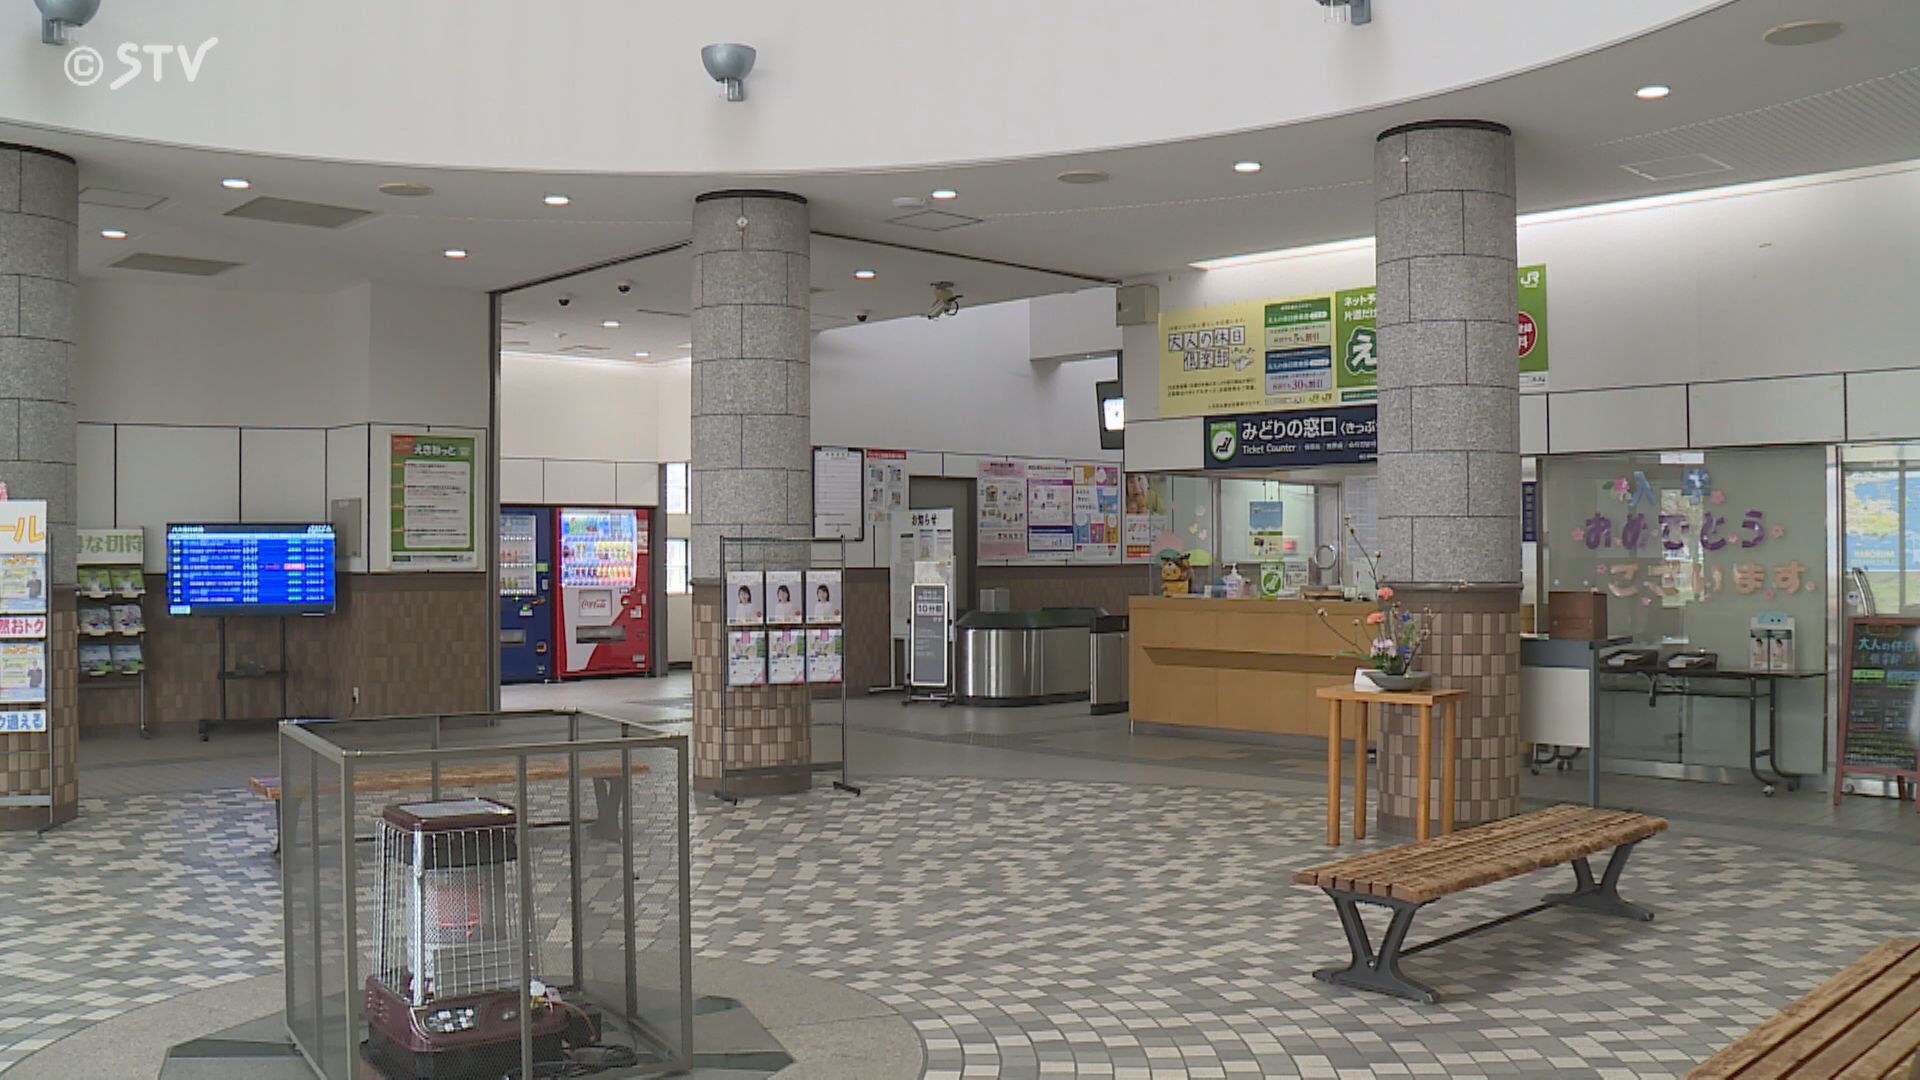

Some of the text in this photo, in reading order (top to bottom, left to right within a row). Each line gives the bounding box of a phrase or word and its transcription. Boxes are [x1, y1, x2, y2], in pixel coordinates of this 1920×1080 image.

[1520, 270, 1540, 285] JR
[1168, 327, 1245, 350] 大人の休日
[1242, 445, 1265, 455] Ticket
[1266, 443, 1296, 453] Counter
[912, 513, 937, 527] お知らせ
